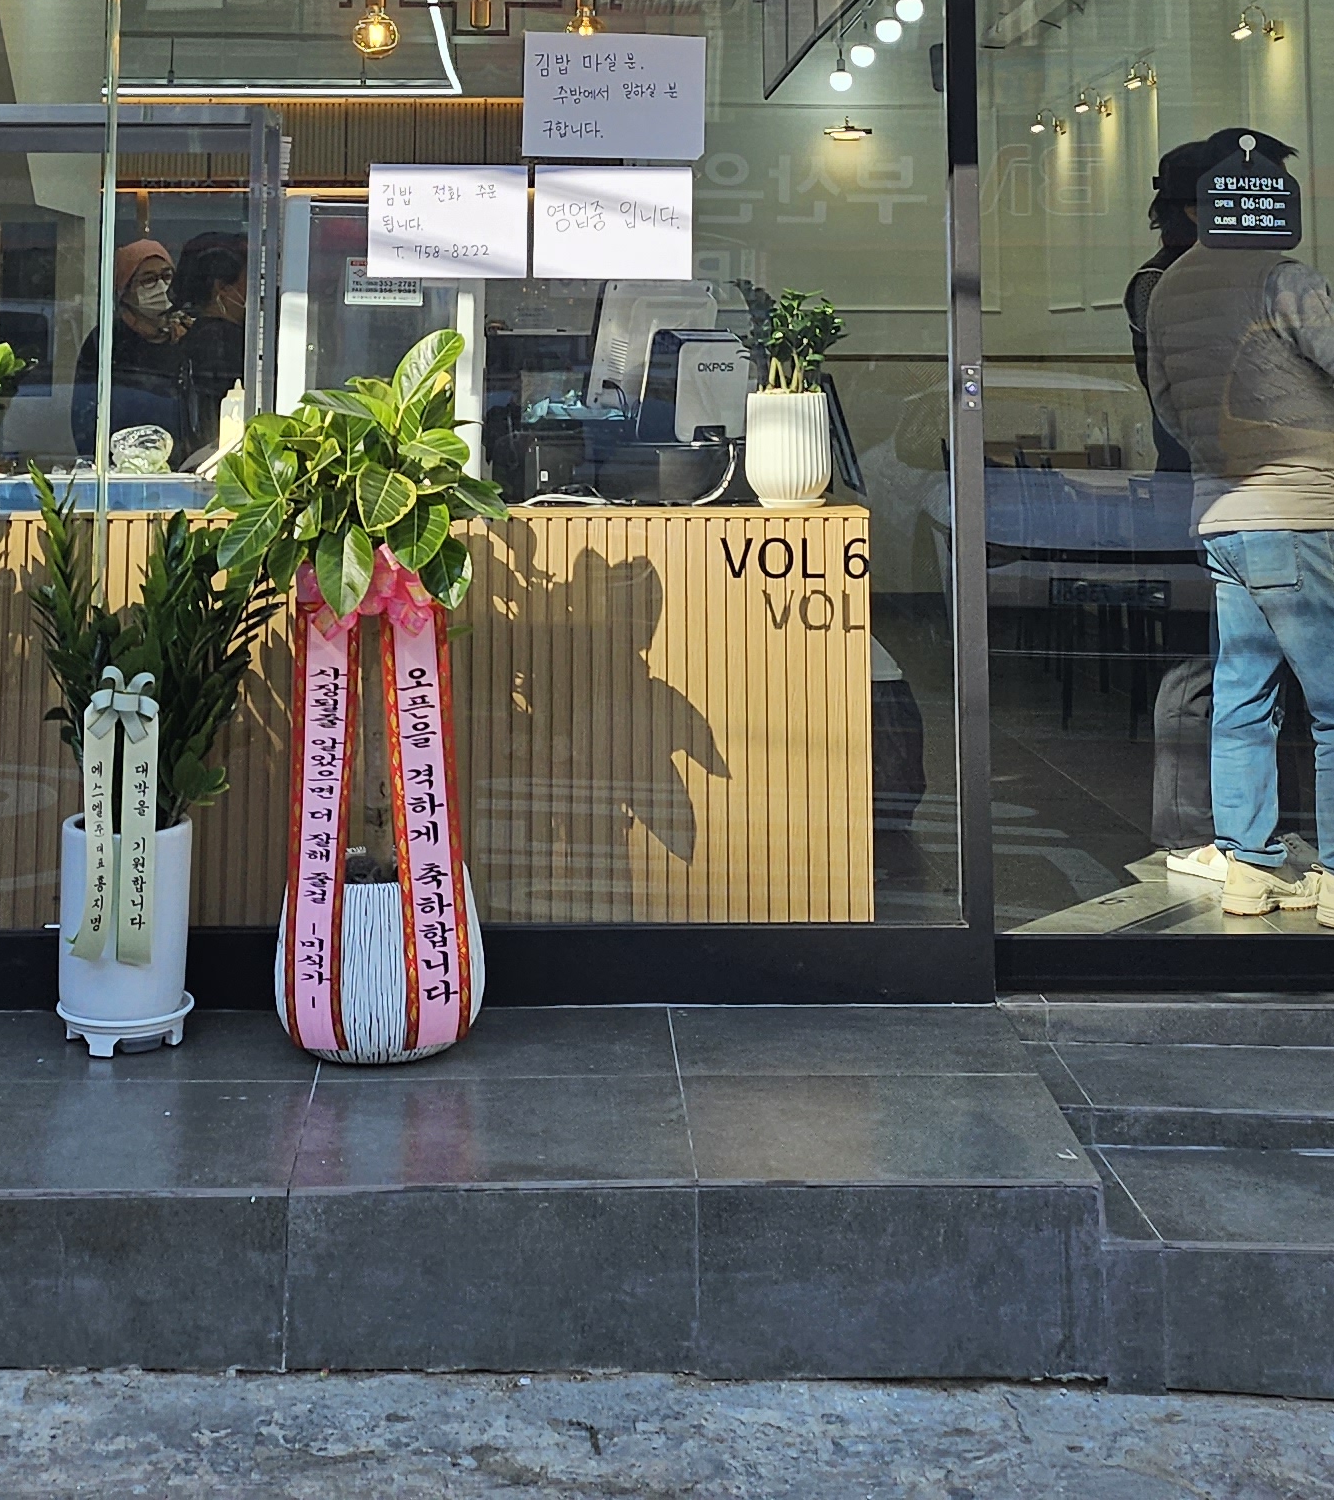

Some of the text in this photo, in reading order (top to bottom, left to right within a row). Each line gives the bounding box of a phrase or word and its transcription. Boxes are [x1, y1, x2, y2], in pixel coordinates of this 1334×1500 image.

[534, 52, 572, 77] 김밥
[552, 81, 679, 105] 주방에서 일하실 분
[542, 119, 605, 140] 구합니다.
[382, 183, 498, 206] 김밥 전화 주문
[1214, 176, 1284, 191] 영업시간안내
[1214, 199, 1234, 209] OPEN
[382, 214, 424, 232] 됩니다.
[546, 200, 682, 233] 영업중 입니다.
[414, 244, 490, 260] 758-8222
[697, 361, 734, 373] OKPOS
[720, 537, 825, 579] VOL
[308, 736, 345, 800] 알았으면
[308, 807, 333, 824] 더
[129, 761, 150, 932] 대박을 기원합니다
[304, 832, 338, 864] 잘해
[396, 667, 459, 1007] 오픈을 격하게 축하합니다
